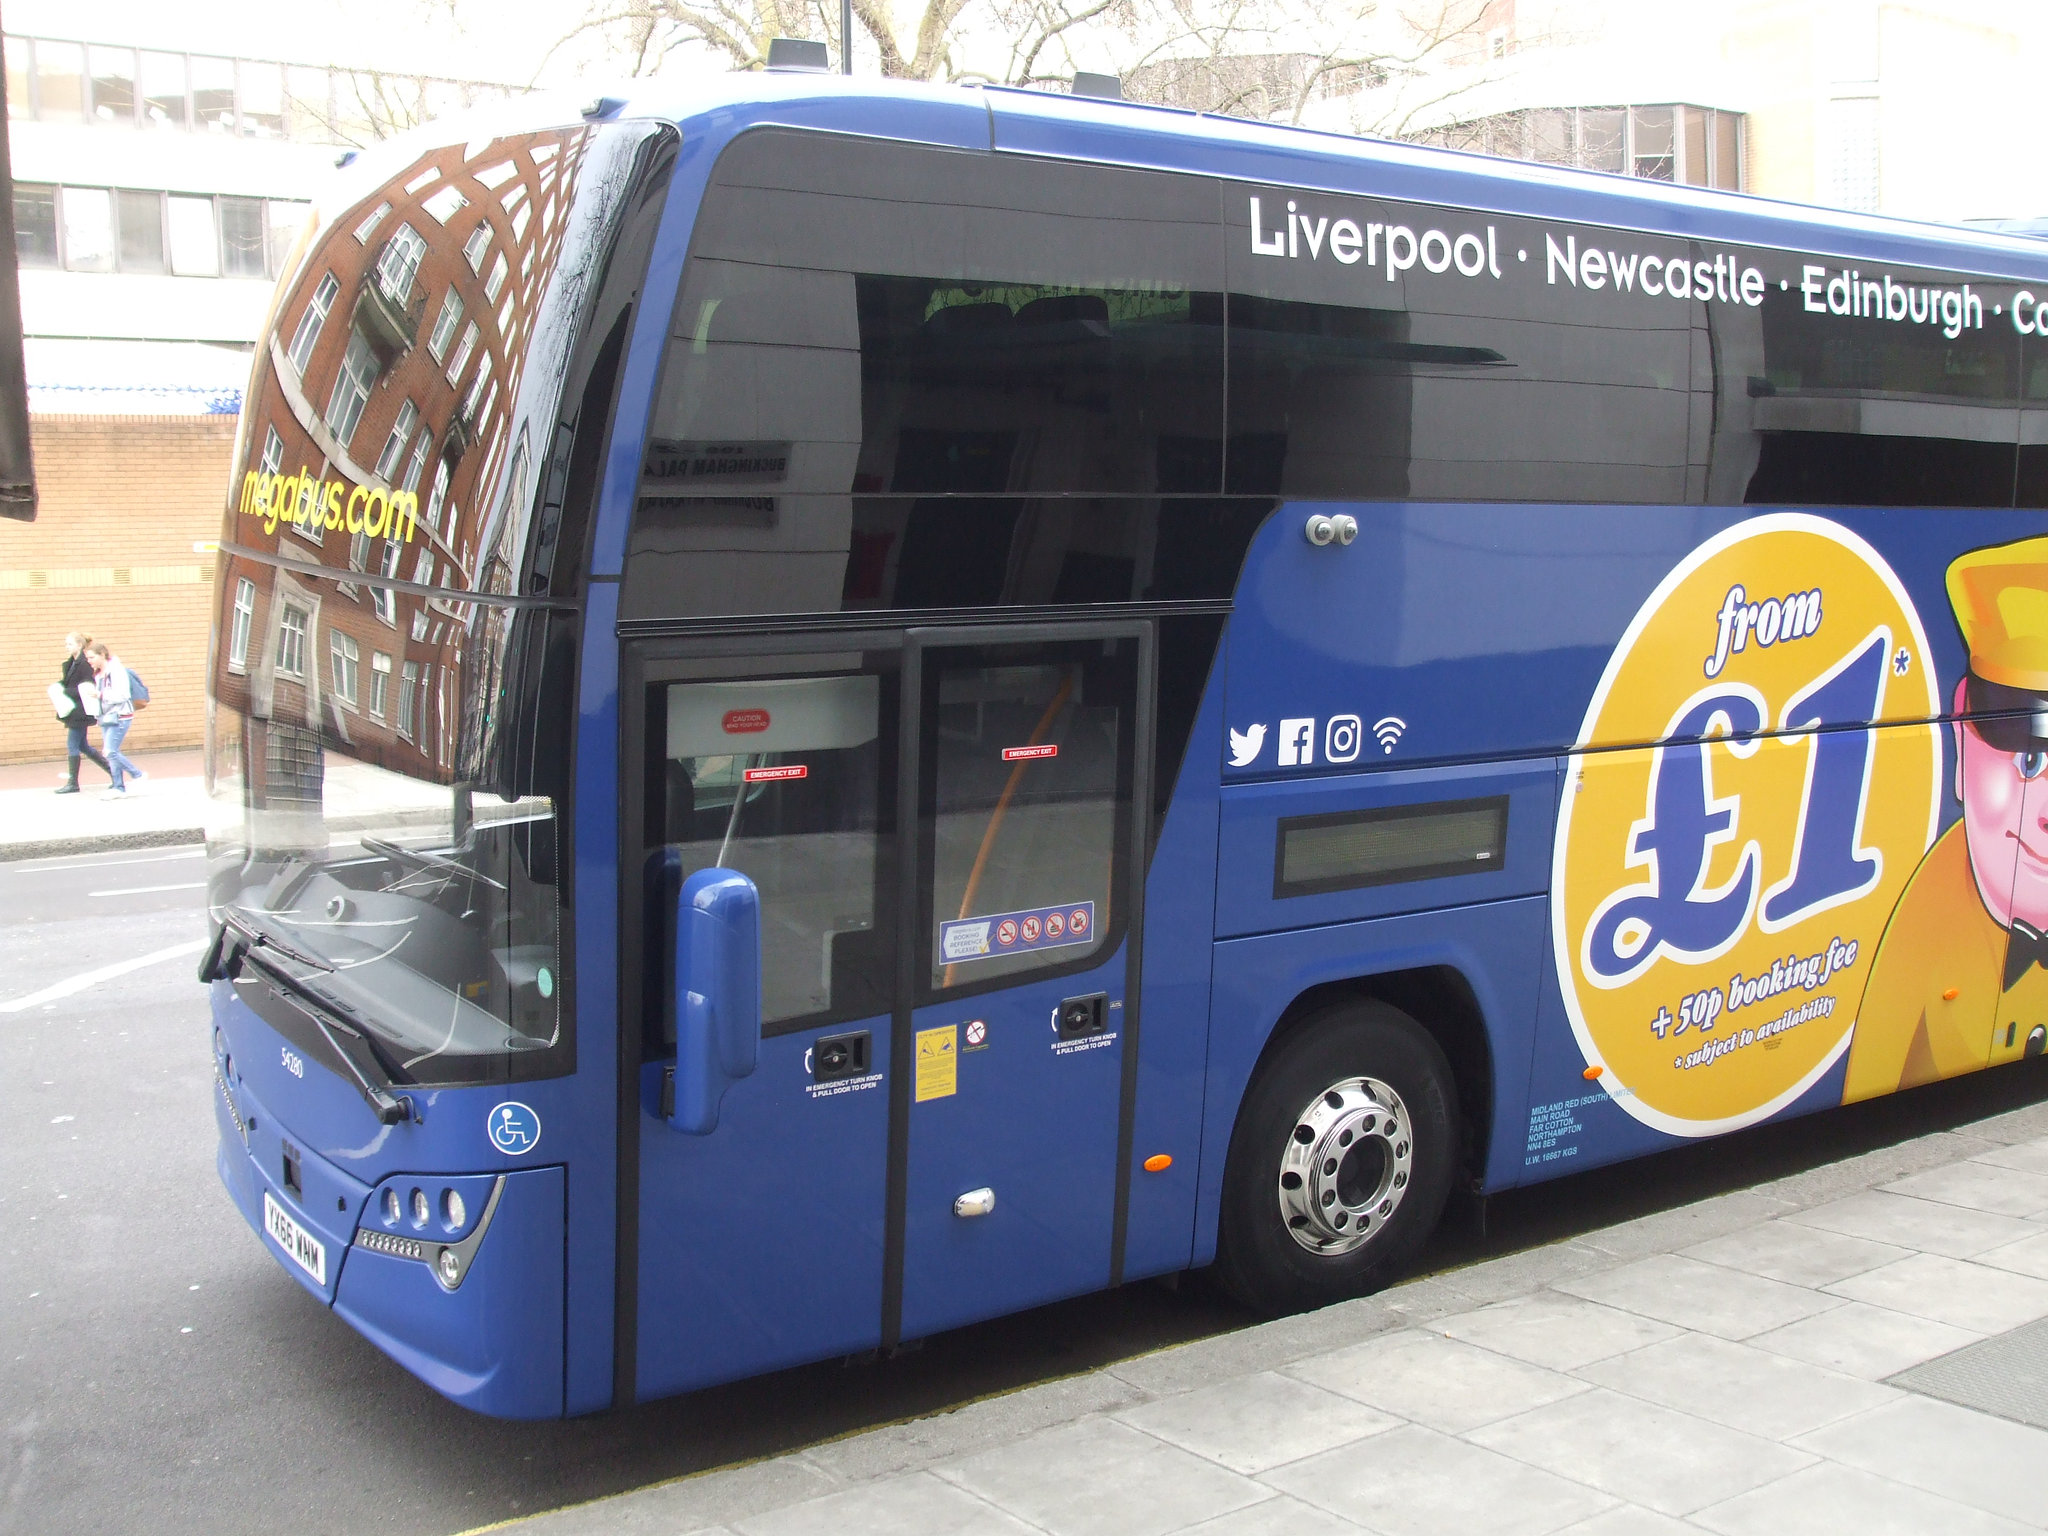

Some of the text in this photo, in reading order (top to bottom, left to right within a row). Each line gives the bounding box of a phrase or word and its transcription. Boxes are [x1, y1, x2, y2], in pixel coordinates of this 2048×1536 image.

[1250, 197, 1502, 282] Liverpool
[1545, 232, 1765, 306] Newcastle
[1801, 265, 1983, 339] Edinburgh
[239, 465, 418, 543] megabus.com
[1704, 584, 1822, 679] from
[732, 714, 762, 723] CAUTION
[1009, 749, 1041, 758] EMERGENCY
[750, 768, 802, 779] EMERGENCY EXIT
[1674, 987, 1724, 1034] 50p
[1727, 953, 1823, 1013] booking
[1819, 936, 1858, 985] fee
[1739, 1028, 1755, 1049] to
[1755, 996, 1836, 1042] availability
[1057, 1038, 1088, 1048] EMERGENCY
[1102, 1032, 1117, 1040] KNOB
[1060, 1047, 1074, 1055] PULL
[1074, 1044, 1089, 1052] DOOR
[1097, 1040, 1112, 1048] OPEN
[281, 1047, 303, 1079] 54280
[813, 1080, 849, 1091] EMERGENCY
[866, 1074, 883, 1082] KNOB
[817, 1089, 833, 1097] PULL
[833, 1087, 851, 1095] DOOR
[860, 1082, 877, 1090] OPEN
[1531, 1102, 1563, 1116] MIDLAND
[1564, 1099, 1580, 1109] RED
[1580, 1093, 1609, 1107] (SOUTH)
[1529, 1117, 1574, 1134] FAR COTTON
[1530, 1109, 1571, 1125] MAIN ROAD
[1527, 1124, 1582, 1143] NORTHAMPTON
[1526, 1141, 1541, 1152] NN4
[1525, 1155, 1540, 1166] U.W.
[1562, 1146, 1578, 1157] KGS
[267, 1200, 320, 1276] YX66 WNM
